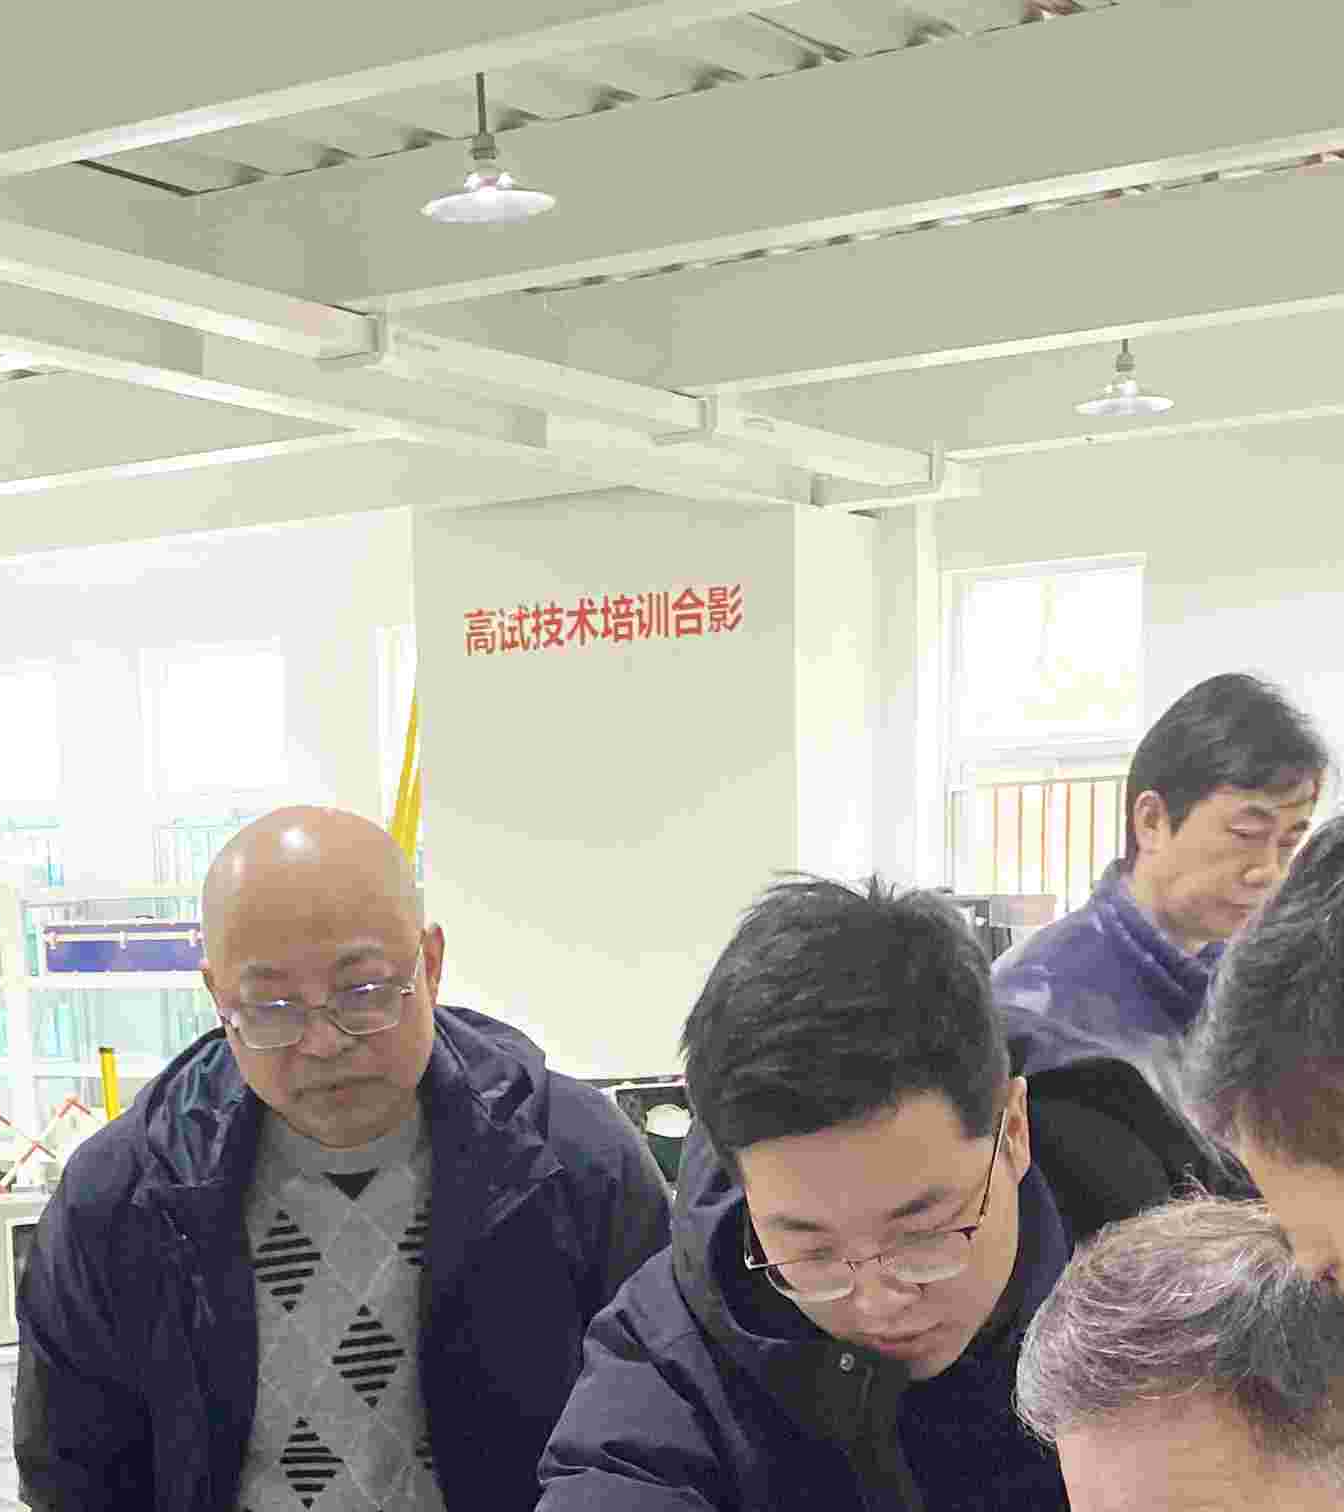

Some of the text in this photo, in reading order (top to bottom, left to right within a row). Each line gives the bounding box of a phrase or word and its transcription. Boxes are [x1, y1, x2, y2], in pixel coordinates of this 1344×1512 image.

[463, 584, 744, 656] 高试技术培训合影
